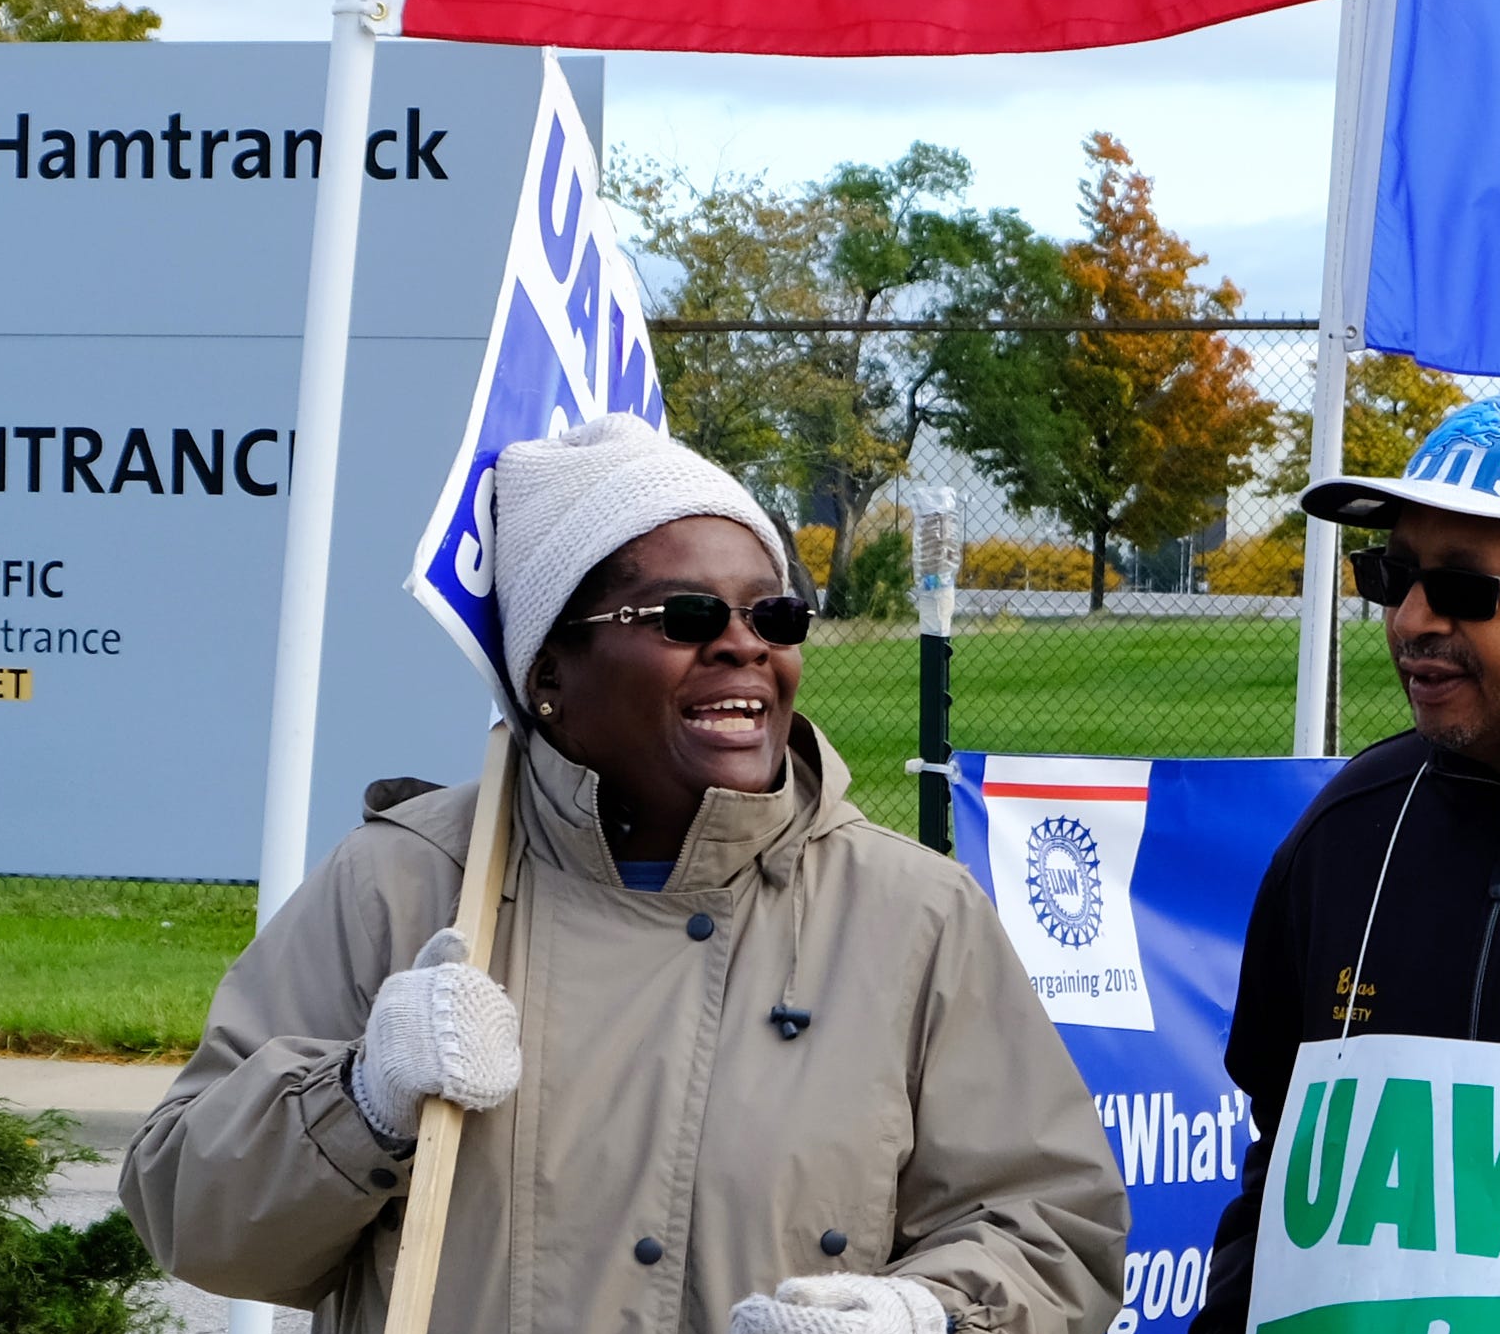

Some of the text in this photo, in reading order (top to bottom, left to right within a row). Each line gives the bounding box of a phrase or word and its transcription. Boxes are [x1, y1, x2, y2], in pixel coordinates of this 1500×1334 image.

[1049, 868, 1080, 897] UAW
[1029, 968, 1139, 999] argaining 2019
[1332, 1006, 1372, 1021] SAETY
[1093, 1089, 1262, 1187] “What’
